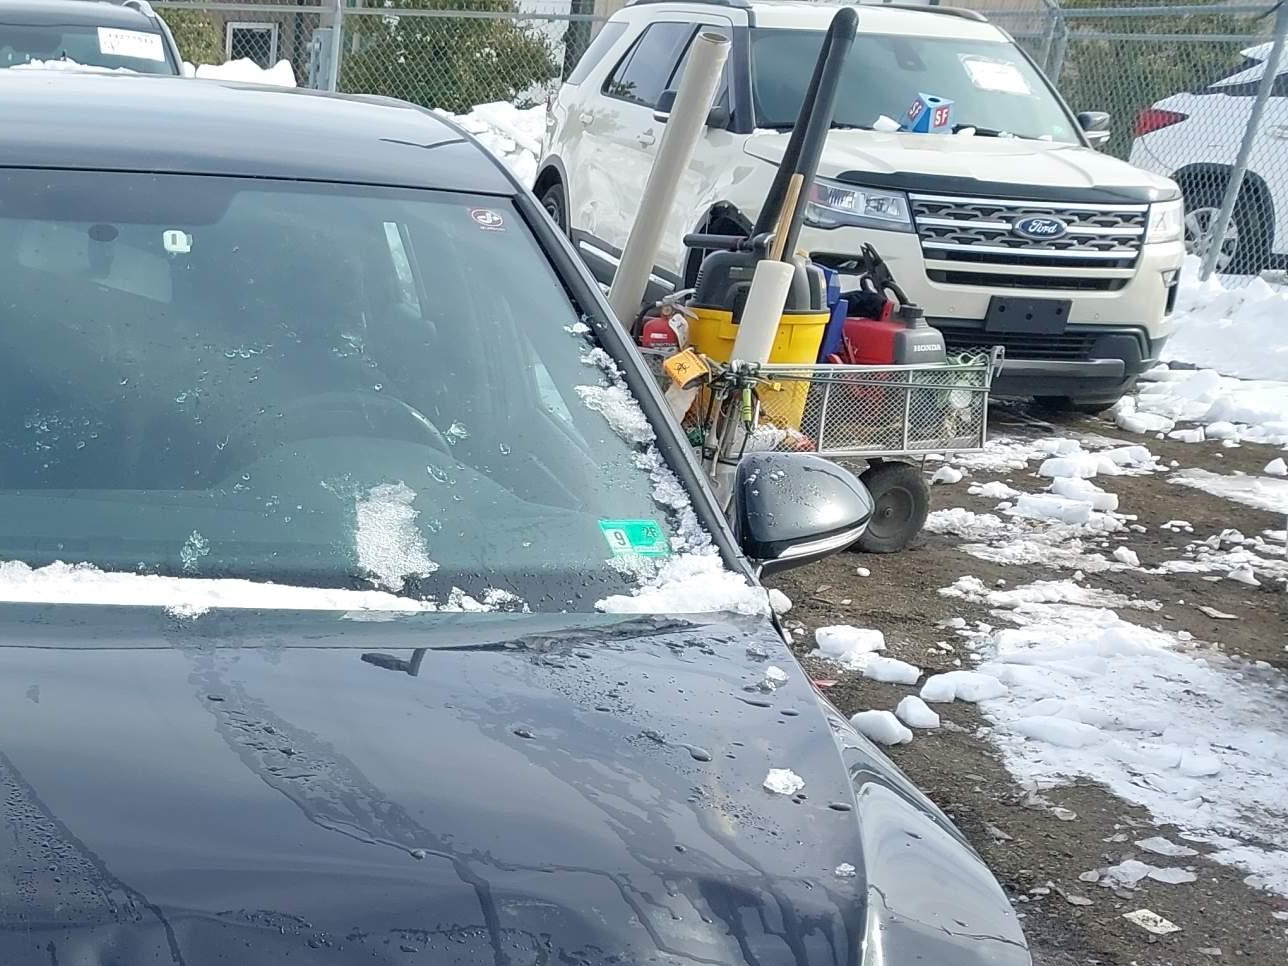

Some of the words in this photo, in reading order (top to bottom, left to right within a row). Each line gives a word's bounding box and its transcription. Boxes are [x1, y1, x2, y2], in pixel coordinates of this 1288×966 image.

[934, 108, 949, 126] SF
[1028, 219, 1058, 234] Ford
[912, 343, 943, 353] HONDA
[613, 531, 627, 546] 9
